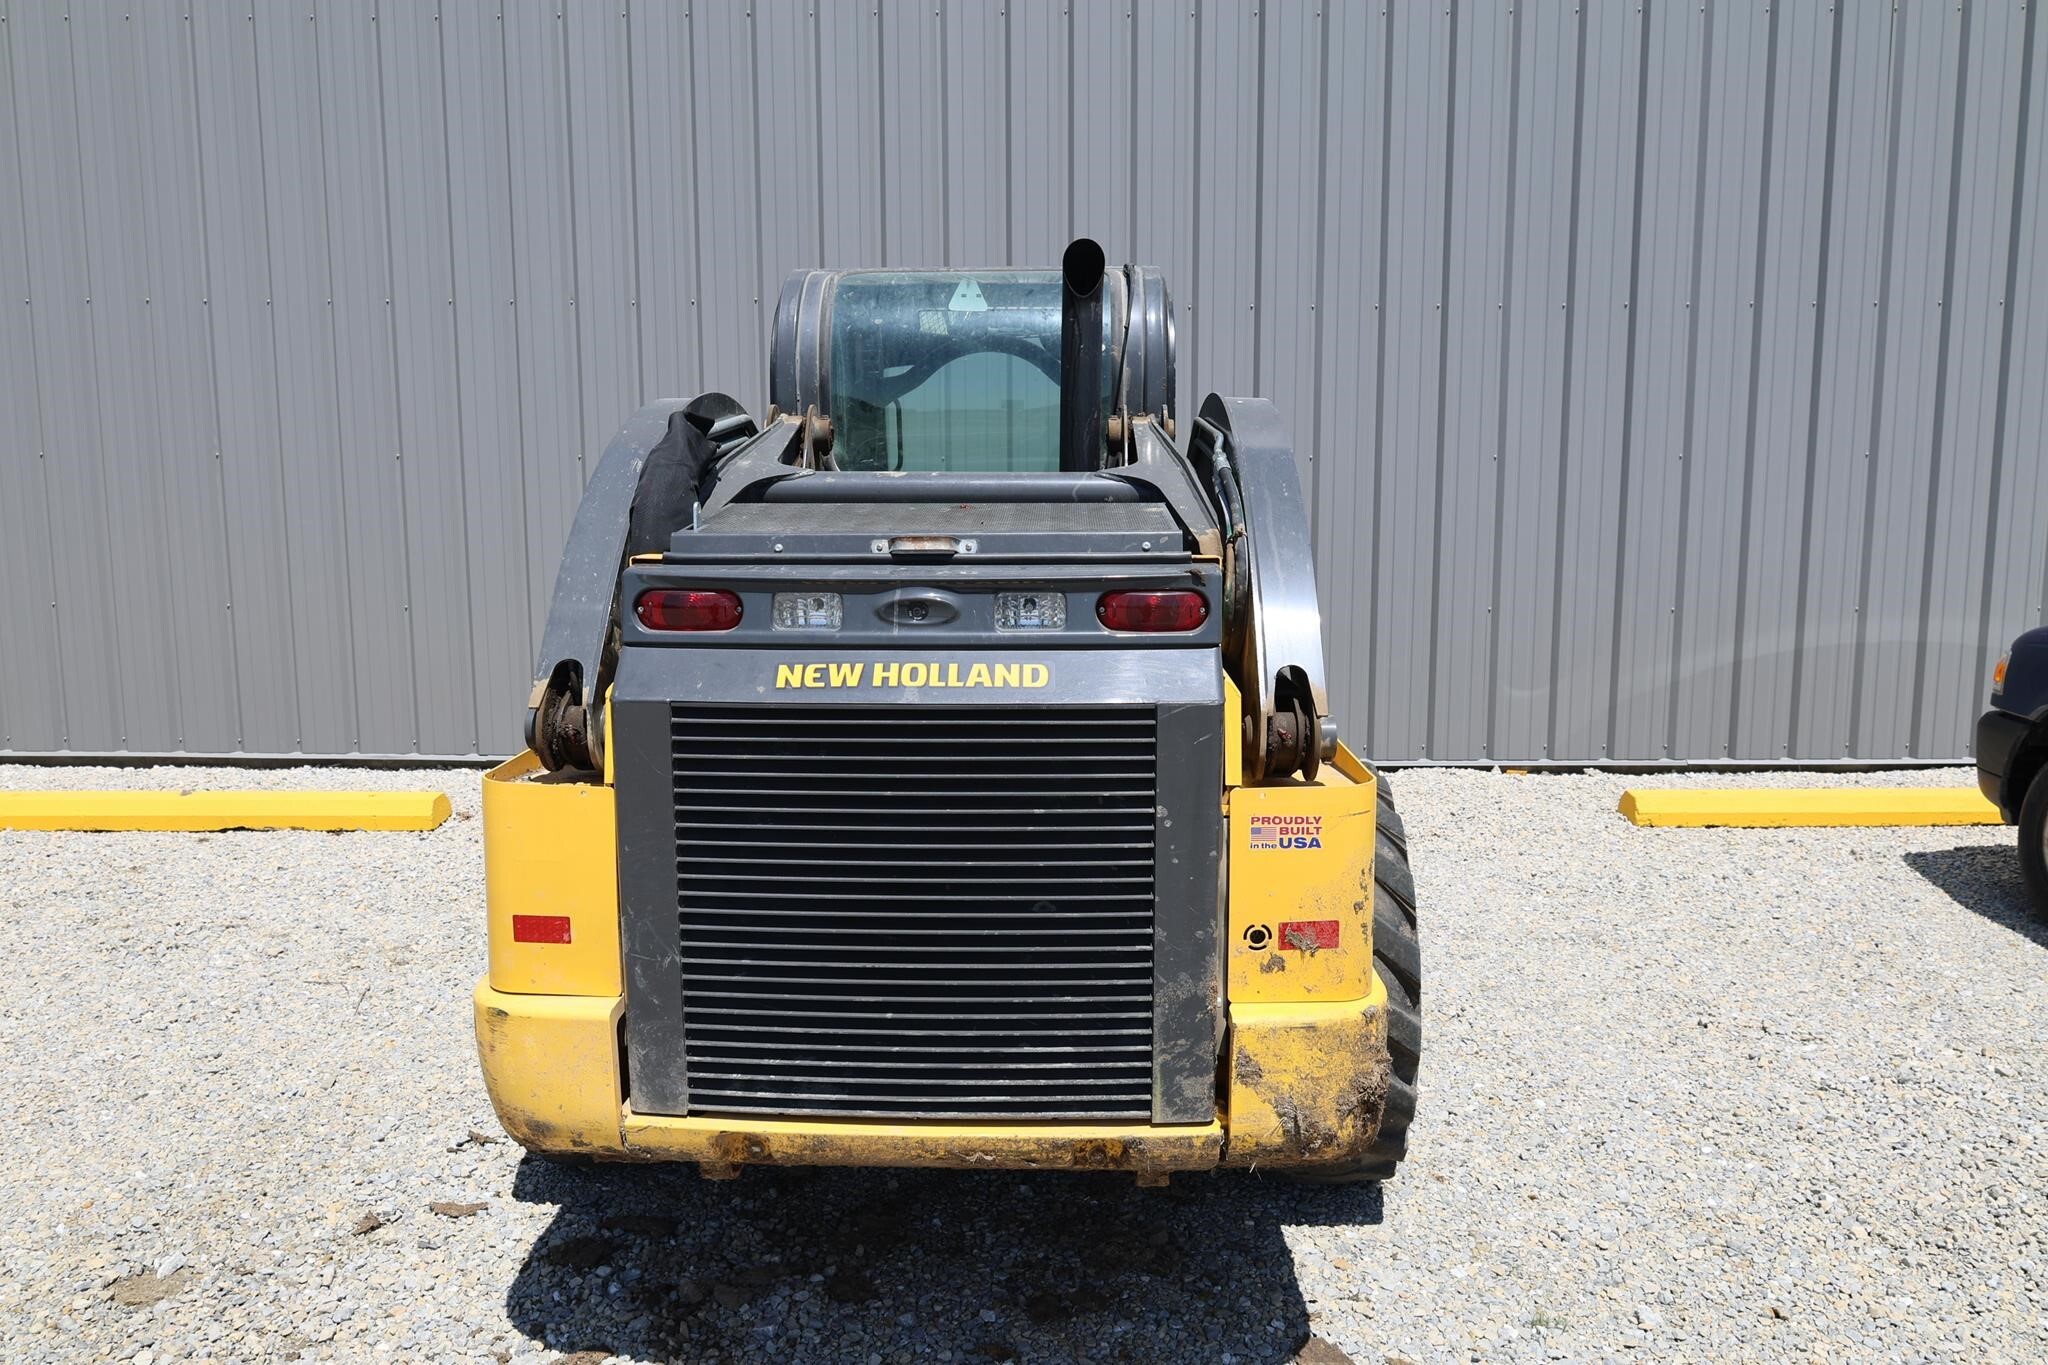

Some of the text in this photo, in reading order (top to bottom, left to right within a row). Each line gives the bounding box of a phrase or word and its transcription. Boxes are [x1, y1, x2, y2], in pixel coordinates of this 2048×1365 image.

[776, 663, 1050, 688] NEW HOLLAND
[1251, 816, 1322, 825] PROUDLY
[1279, 827, 1322, 835] BUILT
[1279, 837, 1322, 849] USA
